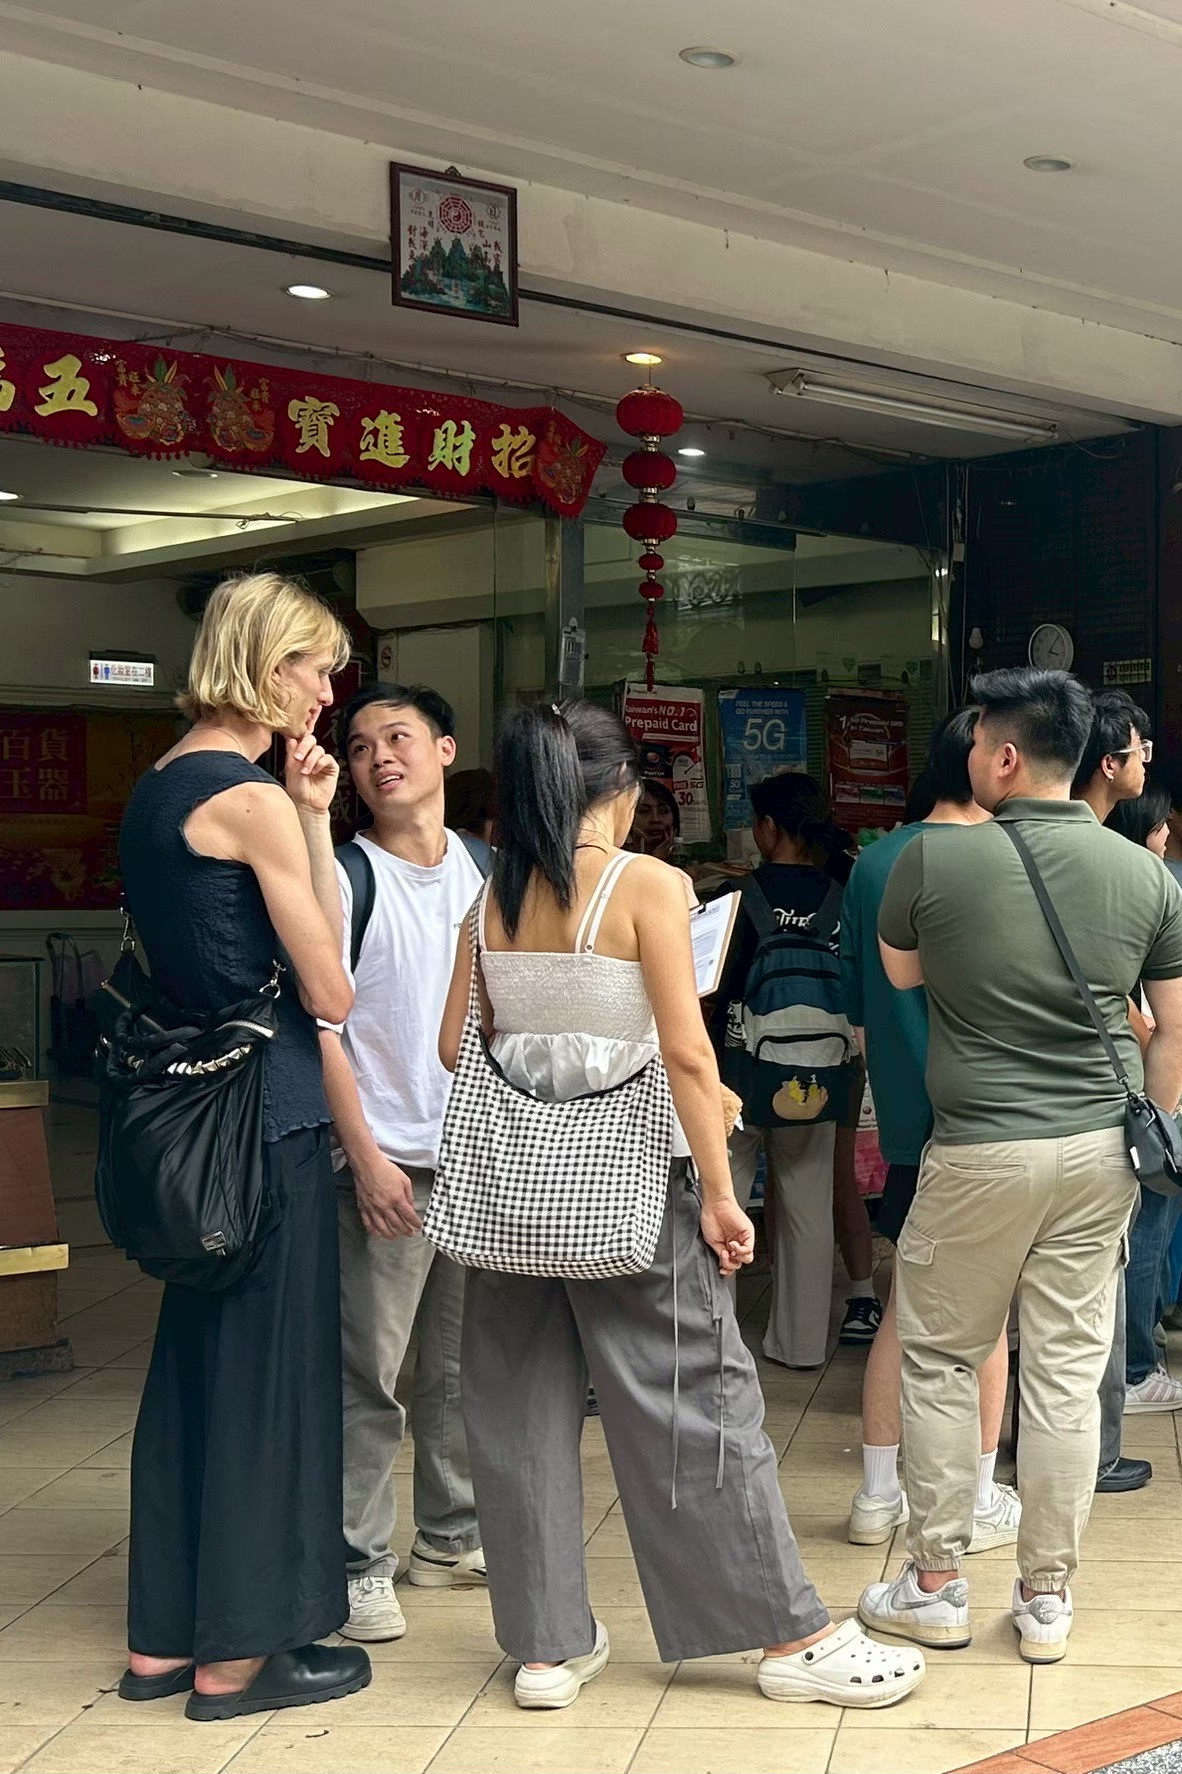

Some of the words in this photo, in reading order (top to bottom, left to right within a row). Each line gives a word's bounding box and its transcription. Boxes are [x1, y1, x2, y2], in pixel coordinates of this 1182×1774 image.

[625, 716, 669, 732] Prepaid
[671, 719, 698, 732] Card
[742, 717, 786, 751] 5G
[678, 791, 693, 806] 30
